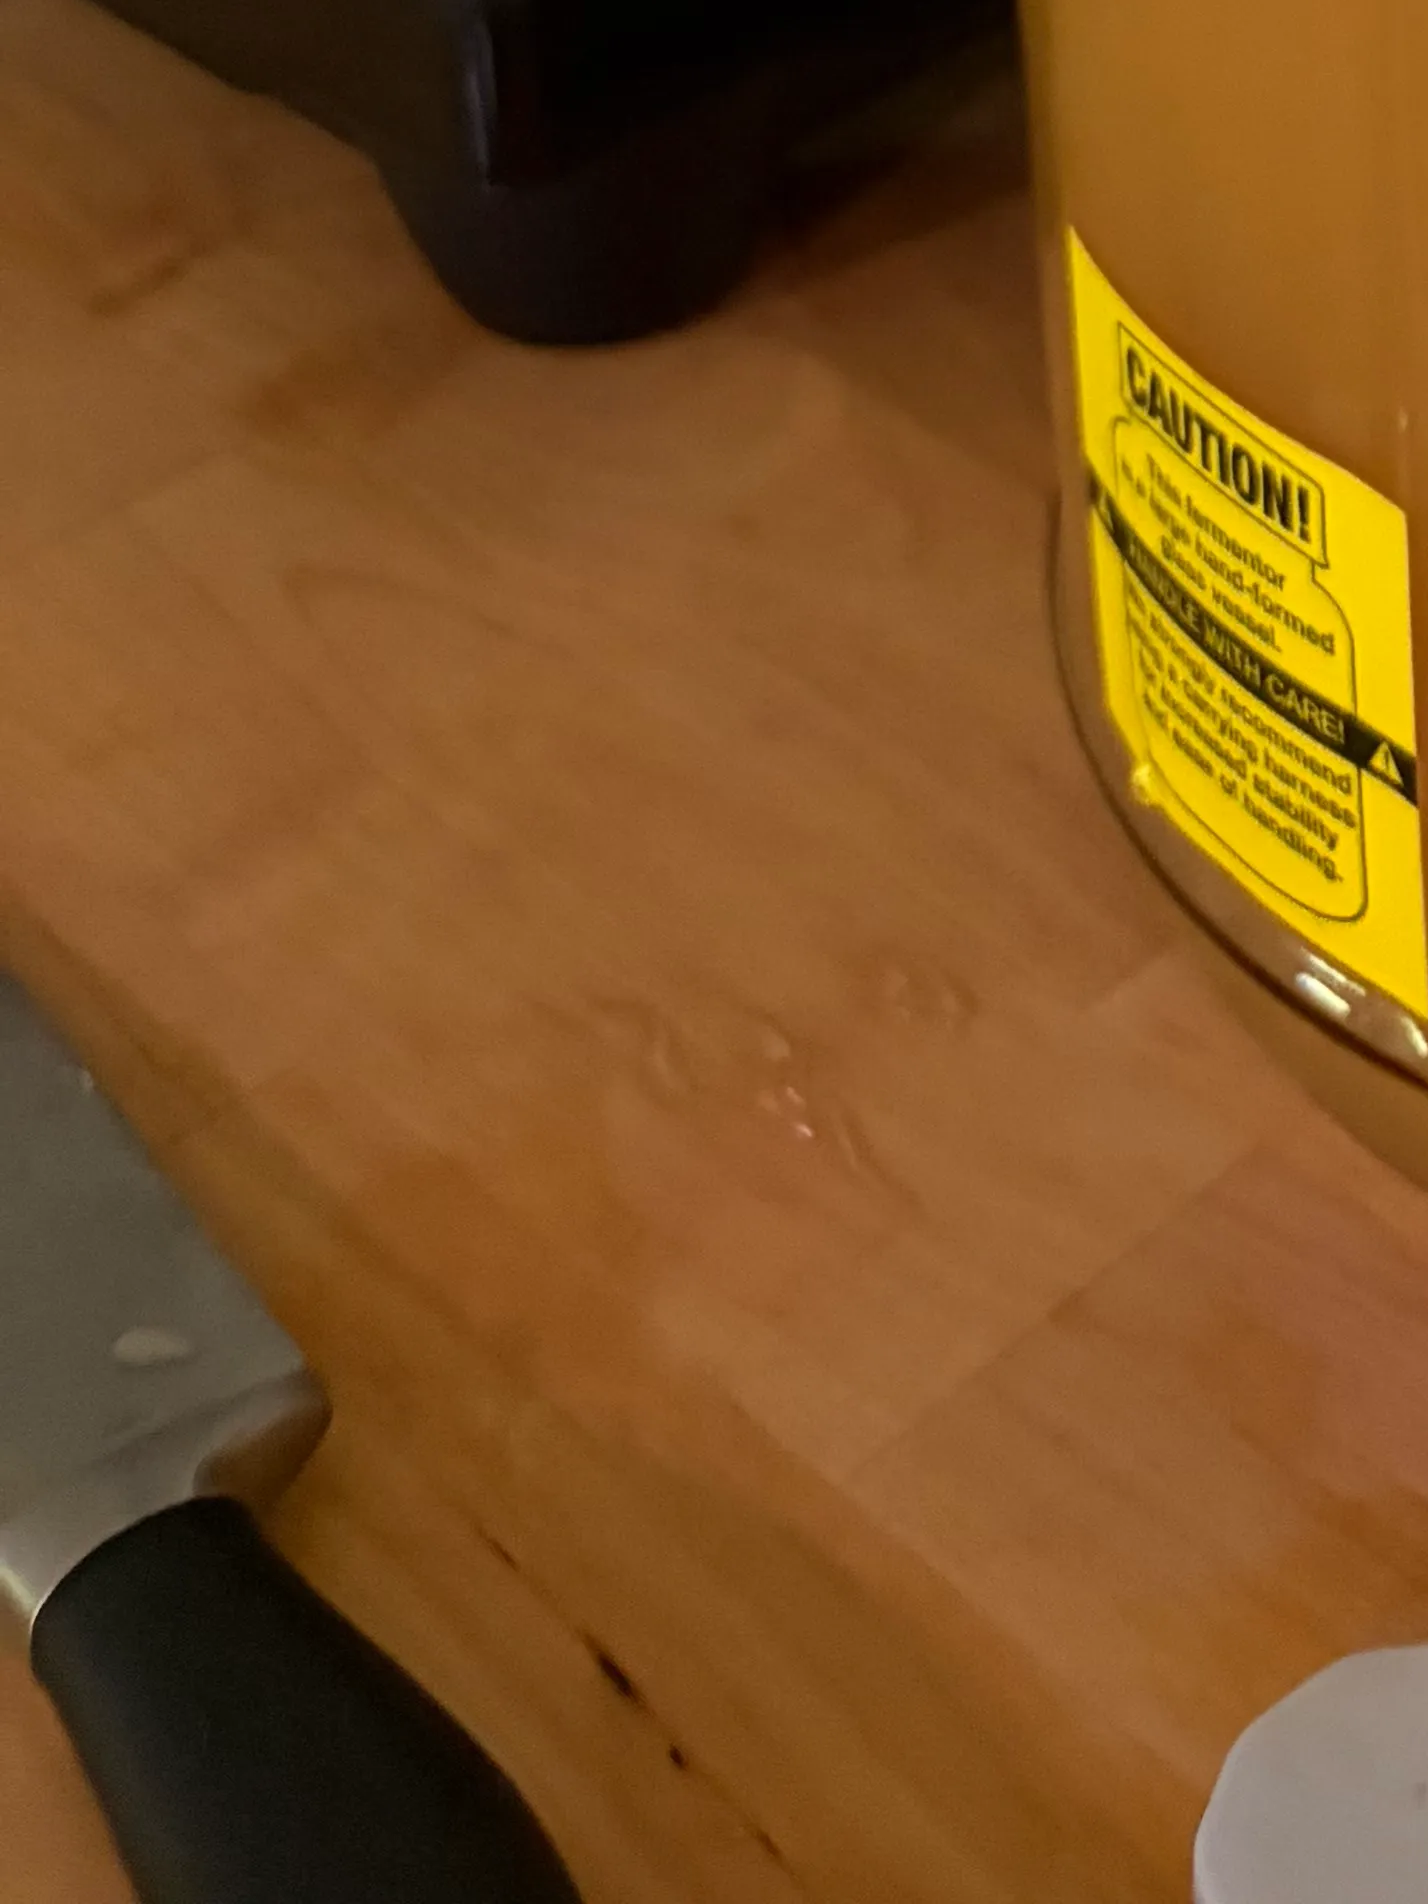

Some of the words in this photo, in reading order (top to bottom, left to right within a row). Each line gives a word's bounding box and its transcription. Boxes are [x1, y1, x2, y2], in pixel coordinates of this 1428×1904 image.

[1127, 346, 1311, 544] CAUTION!
[1186, 492, 1285, 593] fermentor
[1195, 532, 1334, 657] hand-formed
[1205, 617, 1260, 688] WITH
[1266, 670, 1344, 744] CARE!
